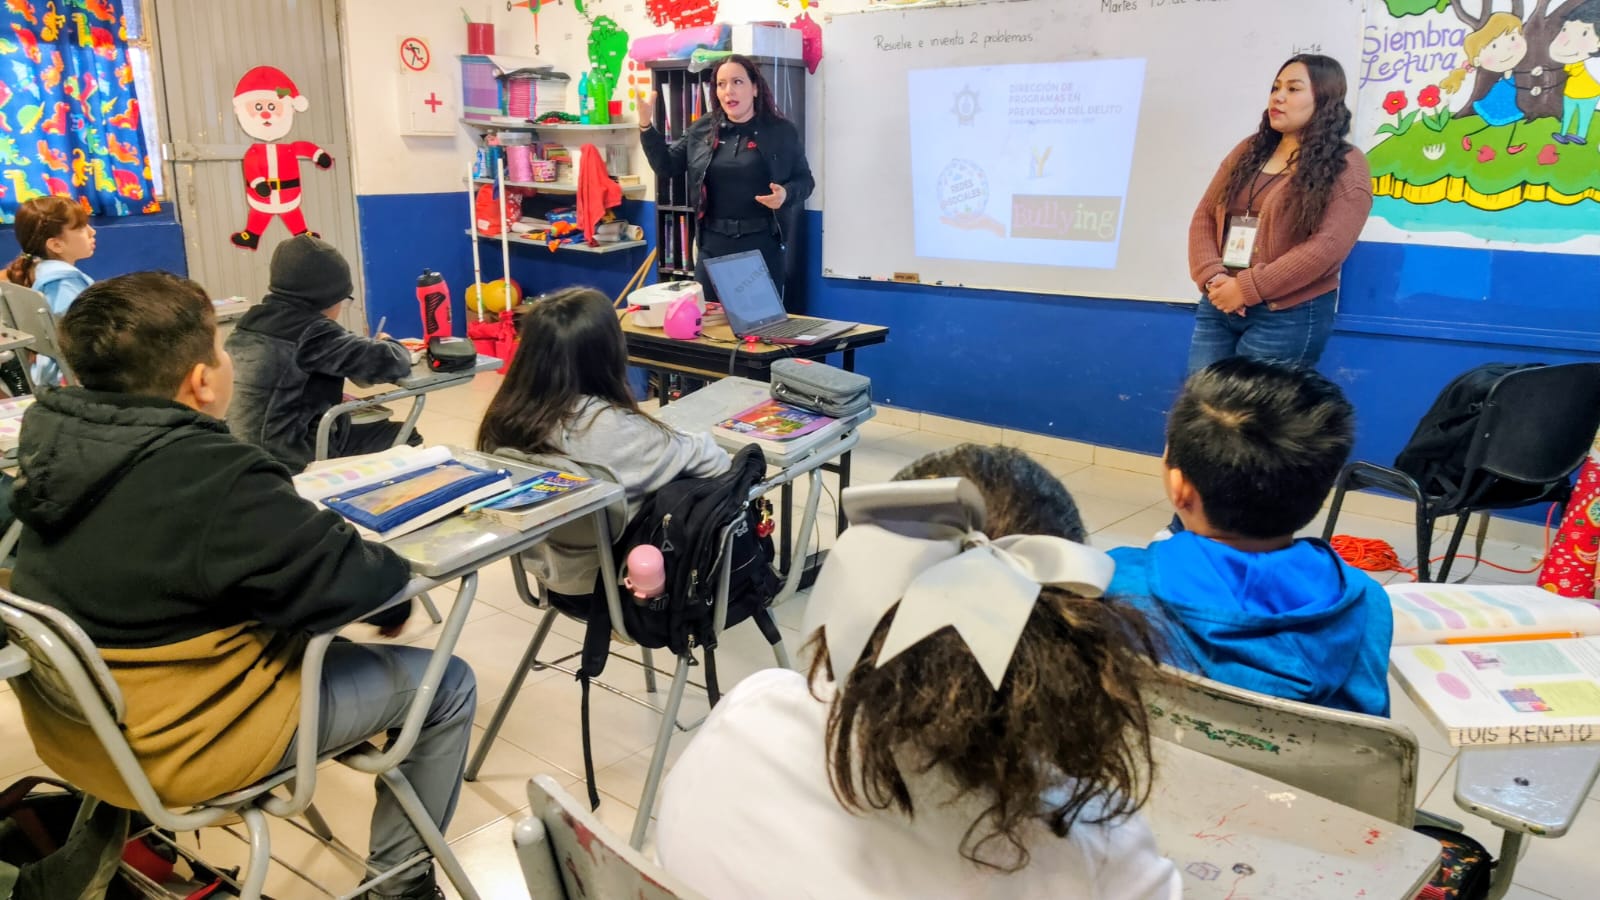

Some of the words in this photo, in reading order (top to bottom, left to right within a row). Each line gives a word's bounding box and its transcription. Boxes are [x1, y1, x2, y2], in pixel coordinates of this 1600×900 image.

[1100, 0, 1137, 13] Martes
[930, 31, 965, 47] inventa
[969, 31, 978, 45] 2
[1361, 20, 1467, 55] Siembra
[1358, 51, 1458, 90] Lectura
[1008, 81, 1059, 93] DIRECCIÓN
[1060, 82, 1074, 92] DE
[1008, 94, 1066, 103] PROGRAMAS
[1067, 93, 1081, 102] EN
[1008, 104, 1066, 116] PREVENCIÓN
[1067, 106, 1086, 115] DEL
[1087, 104, 1123, 114] DELITO
[1012, 200, 1115, 239] Bullying
[1458, 726, 1500, 744] LUIS
